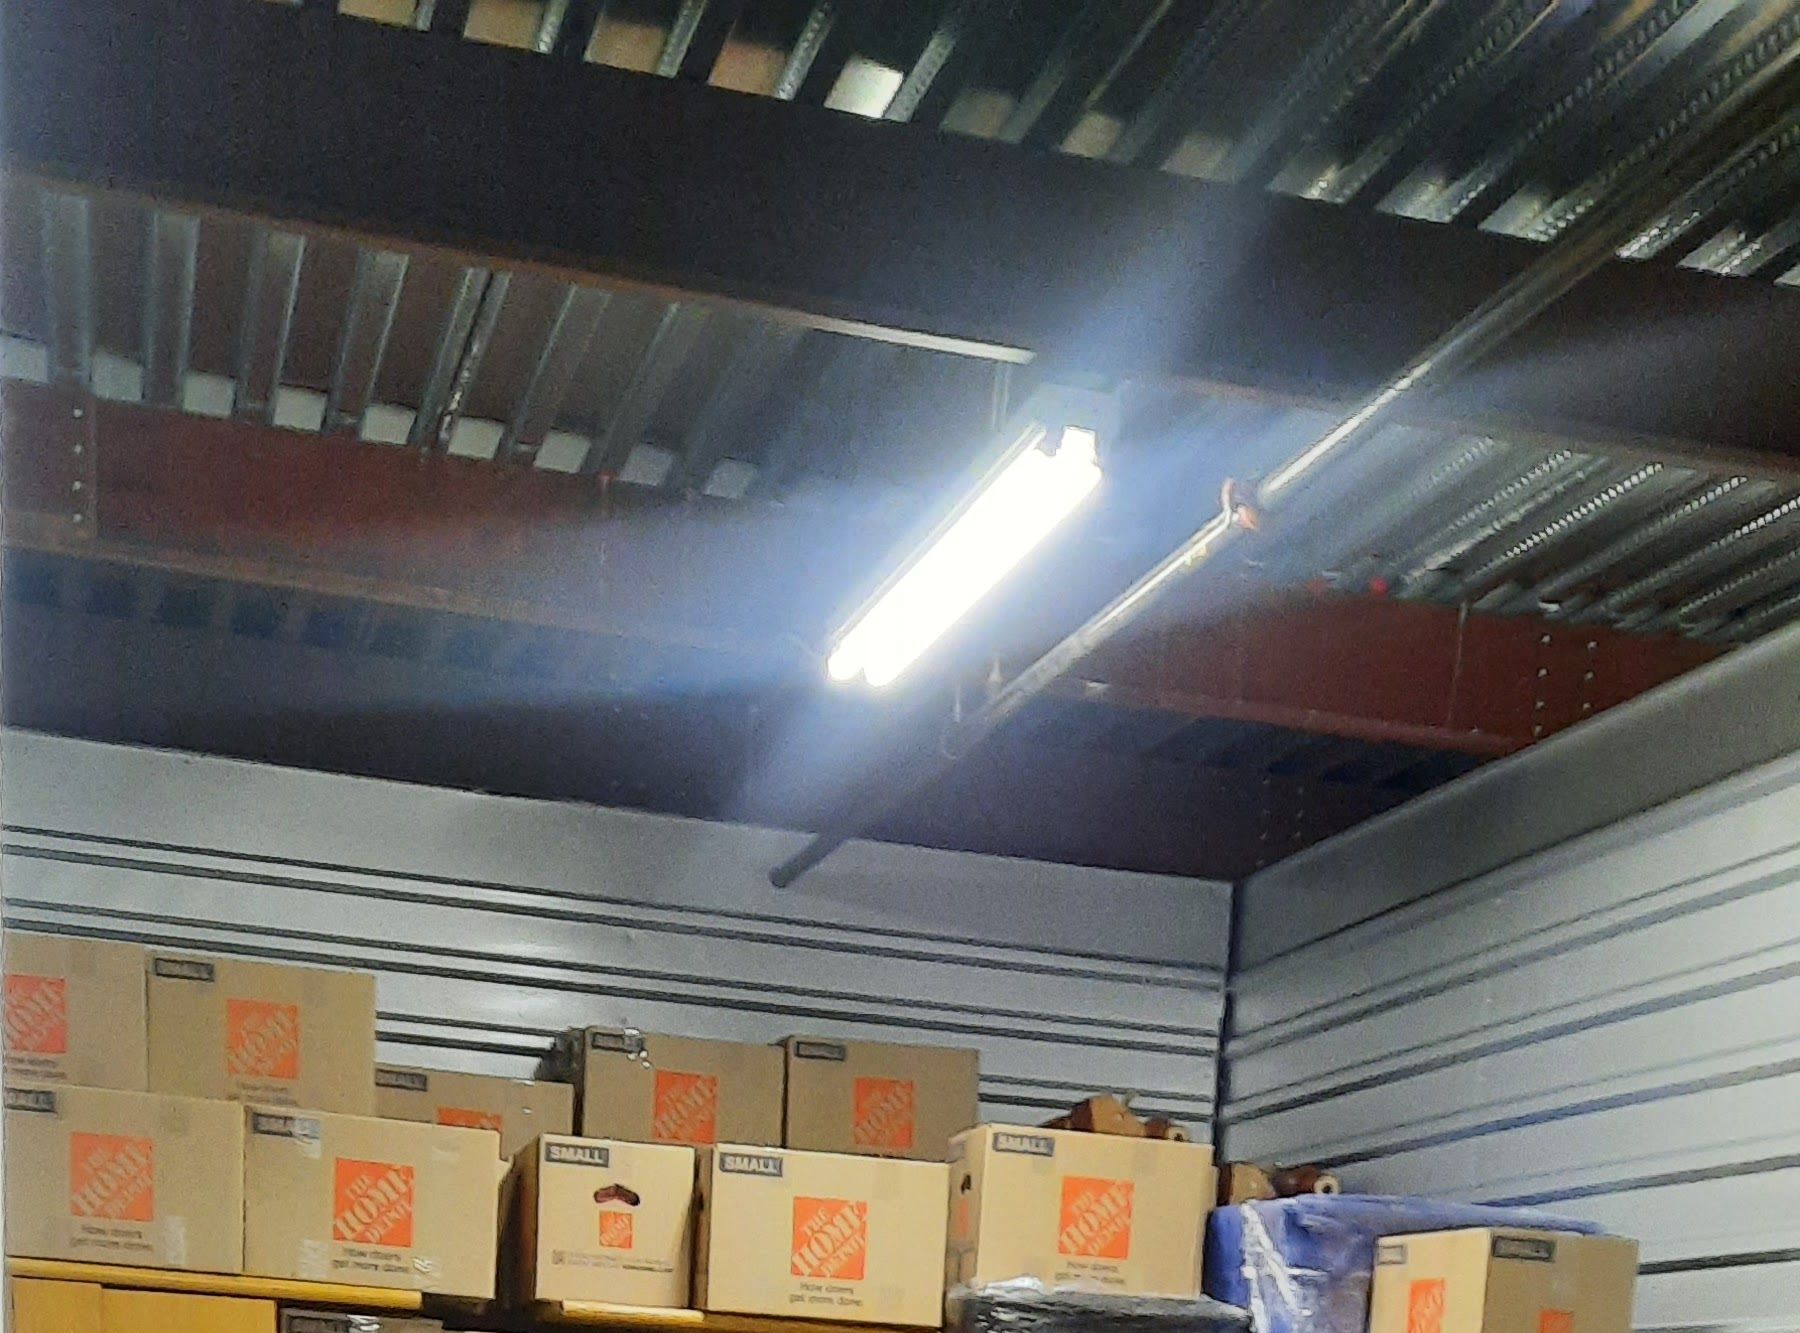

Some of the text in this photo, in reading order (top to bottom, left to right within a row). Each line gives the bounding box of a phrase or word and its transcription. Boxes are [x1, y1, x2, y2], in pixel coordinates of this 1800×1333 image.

[71, 1141, 149, 1216] HOME
[549, 1145, 604, 1162] SMALL
[724, 1156, 778, 1174] SMALL
[335, 1165, 413, 1241] HOME
[800, 1208, 827, 1237] THE
[1060, 1180, 1132, 1256] HOME
[793, 1200, 866, 1276] HOME
[821, 1232, 865, 1278] DEPOT
